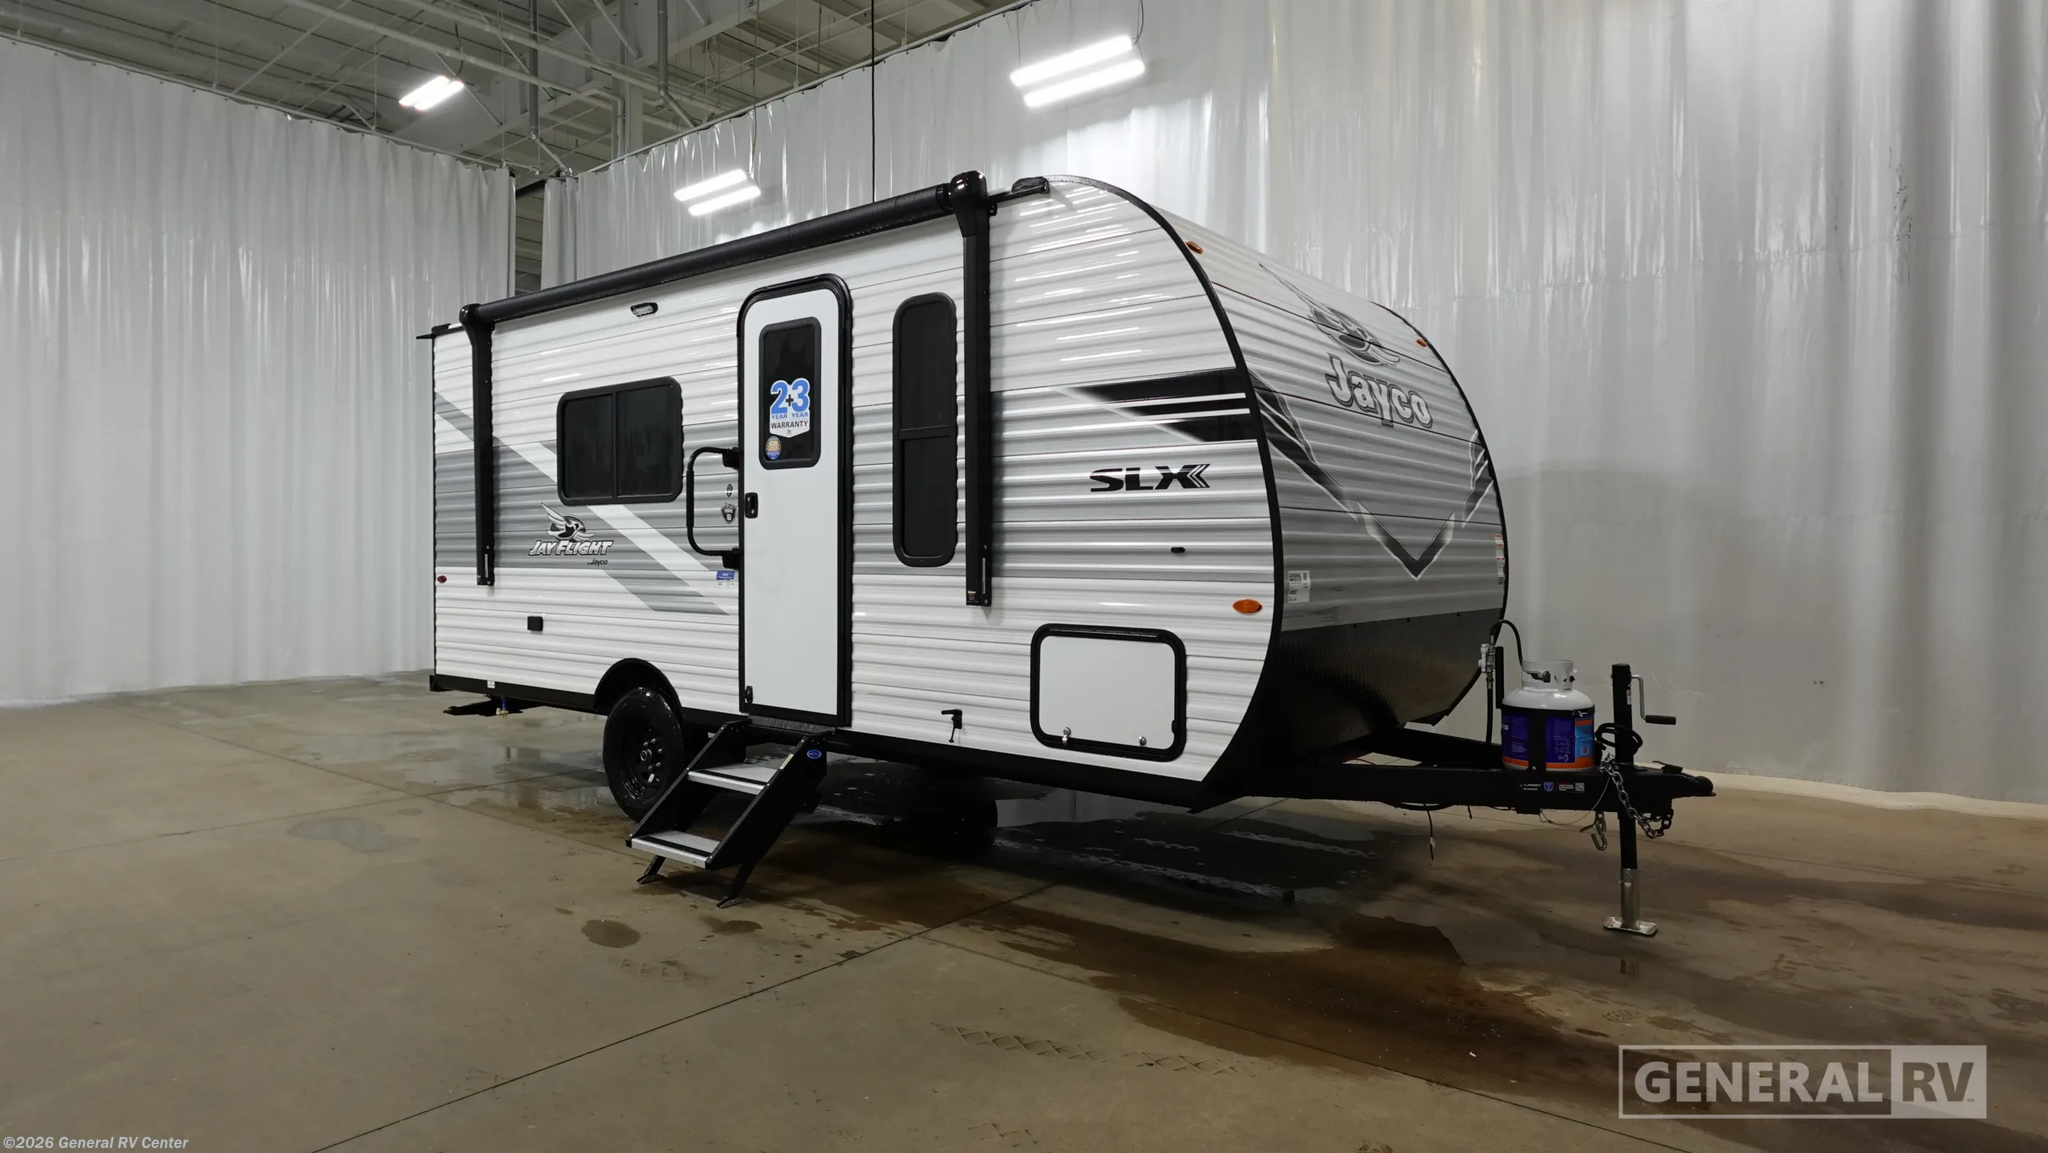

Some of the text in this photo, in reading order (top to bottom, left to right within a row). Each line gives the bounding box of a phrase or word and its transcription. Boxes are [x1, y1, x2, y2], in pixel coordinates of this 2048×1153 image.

[1325, 353, 1433, 428] Jayco
[791, 411, 809, 419] YEAR
[771, 420, 809, 430] WARRANTY
[1089, 463, 1211, 492] SLX
[528, 540, 615, 556] JAY FLIGHT
